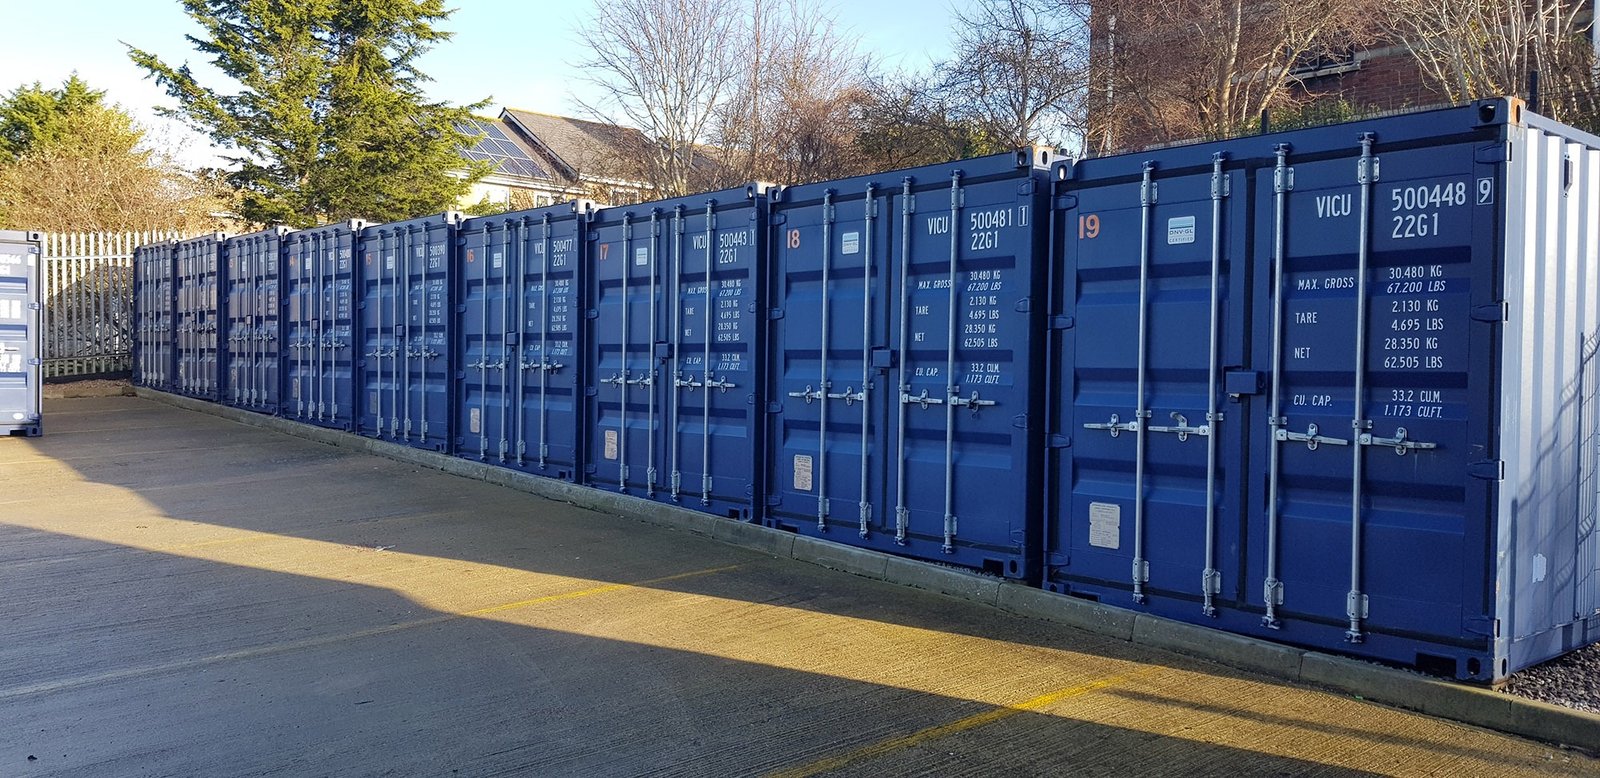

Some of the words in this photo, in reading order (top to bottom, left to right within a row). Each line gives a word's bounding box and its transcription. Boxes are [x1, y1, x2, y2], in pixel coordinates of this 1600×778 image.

[1316, 194, 1352, 218] VICU
[1391, 182, 1466, 212] 500448
[1478, 178, 1493, 204] 9
[928, 216, 948, 235] VICU
[970, 208, 1012, 230] 500481
[1079, 214, 1100, 239] 19
[1392, 212, 1439, 238] 22G1
[692, 235, 706, 250] VICU
[720, 231, 746, 248] 500443
[787, 230, 800, 248] 18
[970, 230, 998, 250] 22G1
[467, 249, 474, 262] 16
[600, 243, 608, 260] 17
[720, 248, 737, 264] 22G1
[970, 271, 990, 280] 30.480
[992, 270, 1000, 280] KG
[1389, 266, 1424, 279] 30.480
[1430, 265, 1442, 277] KG
[918, 280, 931, 290] MAX.
[933, 280, 952, 288] GROSS
[967, 282, 988, 292] 67.200
[990, 282, 1002, 290] LBS
[1298, 279, 1320, 290] MAX.
[1324, 277, 1354, 288] GROSS
[1386, 282, 1422, 294] 67.200
[1428, 280, 1446, 292] LBS
[969, 296, 986, 306] 2.130
[989, 296, 996, 305] KG
[1392, 300, 1420, 312] 2.130
[1426, 300, 1439, 312] KG
[915, 306, 928, 315] TARE
[968, 310, 986, 319] 4.695
[988, 310, 1000, 319] LBS
[1296, 312, 1318, 324] TARE
[964, 324, 986, 334] 28.350
[988, 324, 996, 334] KG
[1391, 319, 1420, 331] 4.695
[1426, 318, 1444, 330] LBS
[914, 332, 924, 341] NET
[964, 338, 984, 347] 62.505
[988, 338, 998, 347] LBS
[1384, 338, 1420, 350] 28.350
[1426, 338, 1438, 350] KG
[1294, 348, 1310, 358] NET
[971, 364, 984, 372] 33.2
[1384, 356, 1419, 368] 62.505
[1426, 356, 1442, 368] LBS
[926, 368, 938, 376] CAP.
[966, 375, 982, 383] 1.173
[1294, 395, 1307, 406] CU.
[1312, 395, 1332, 406] CAP.
[1392, 390, 1414, 402] 33.2
[1420, 390, 1442, 403] CU.M.
[1384, 405, 1411, 416] 1.173
[1418, 406, 1442, 418] CU.FT.
